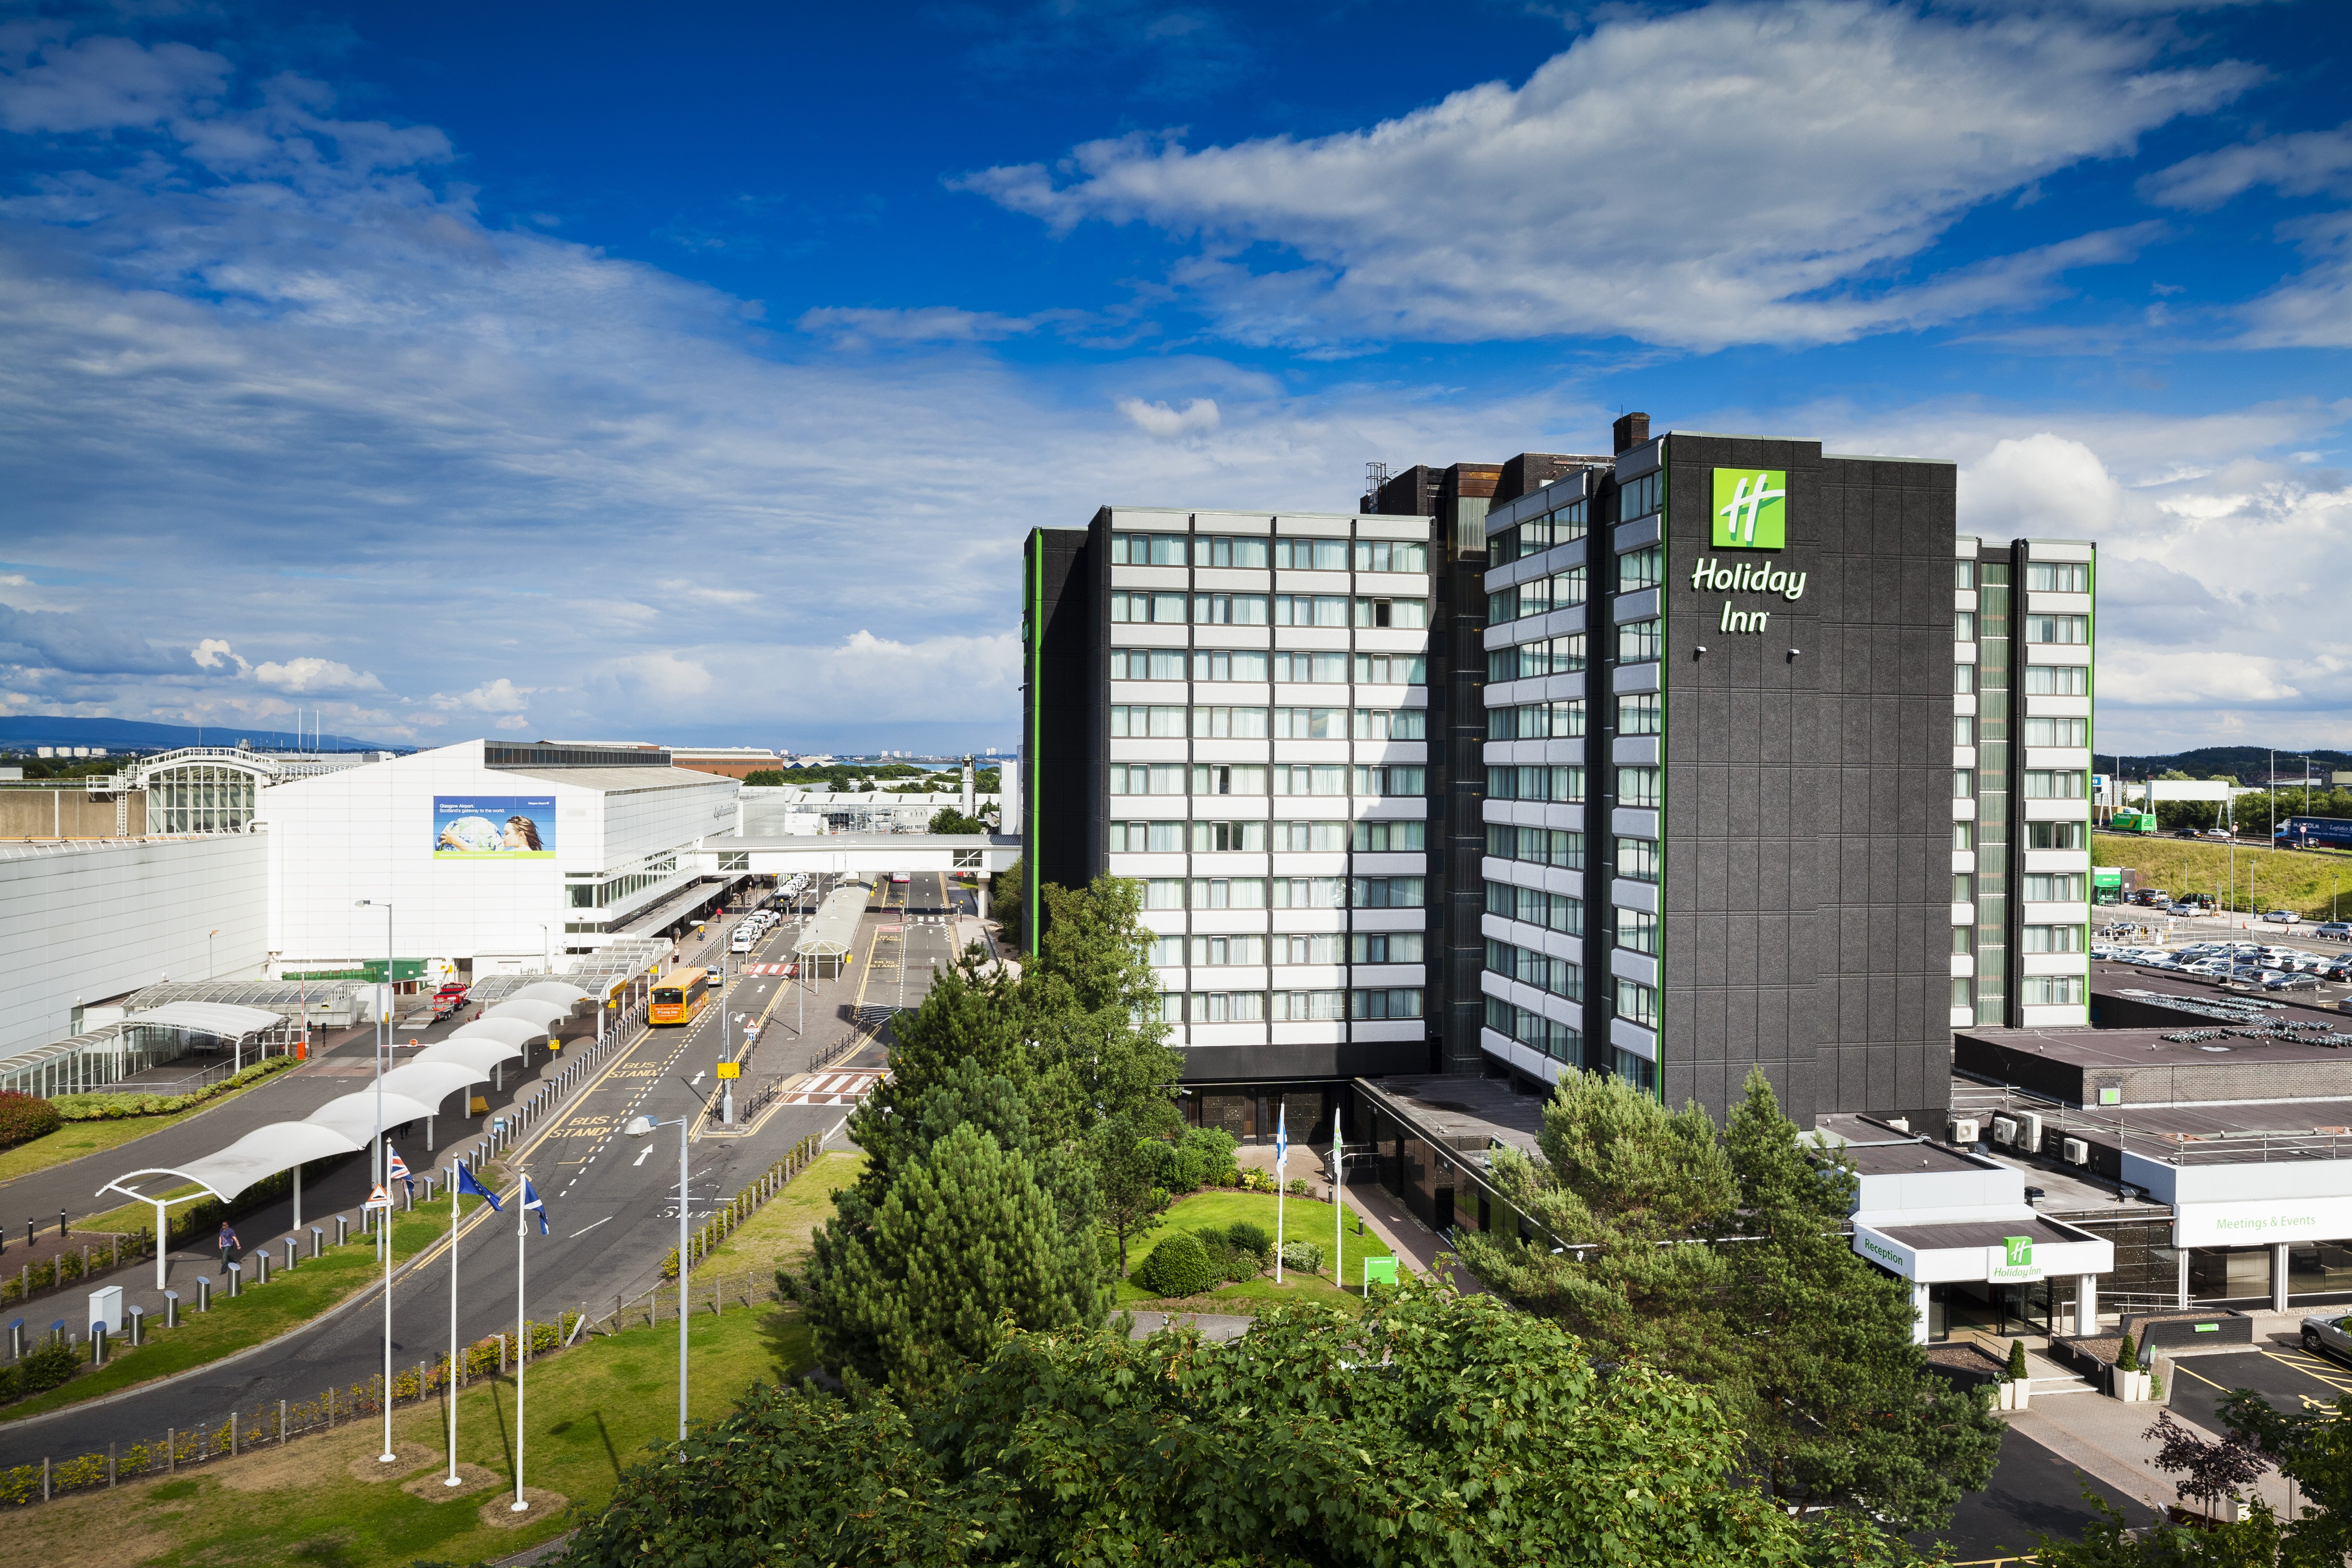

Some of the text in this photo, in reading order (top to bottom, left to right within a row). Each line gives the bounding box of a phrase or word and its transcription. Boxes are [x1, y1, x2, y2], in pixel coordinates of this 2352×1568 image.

[1691, 558, 1807, 600] Holiday
[1720, 600, 1767, 632] Inn
[608, 1070, 655, 1078] STAND
[568, 1116, 610, 1125] BUS
[549, 1128, 605, 1138] STAND
[2217, 1216, 2315, 1230] Meetings & Events
[1865, 1238, 1903, 1266] Reception
[1994, 1266, 2041, 1278] Holiday Inn
